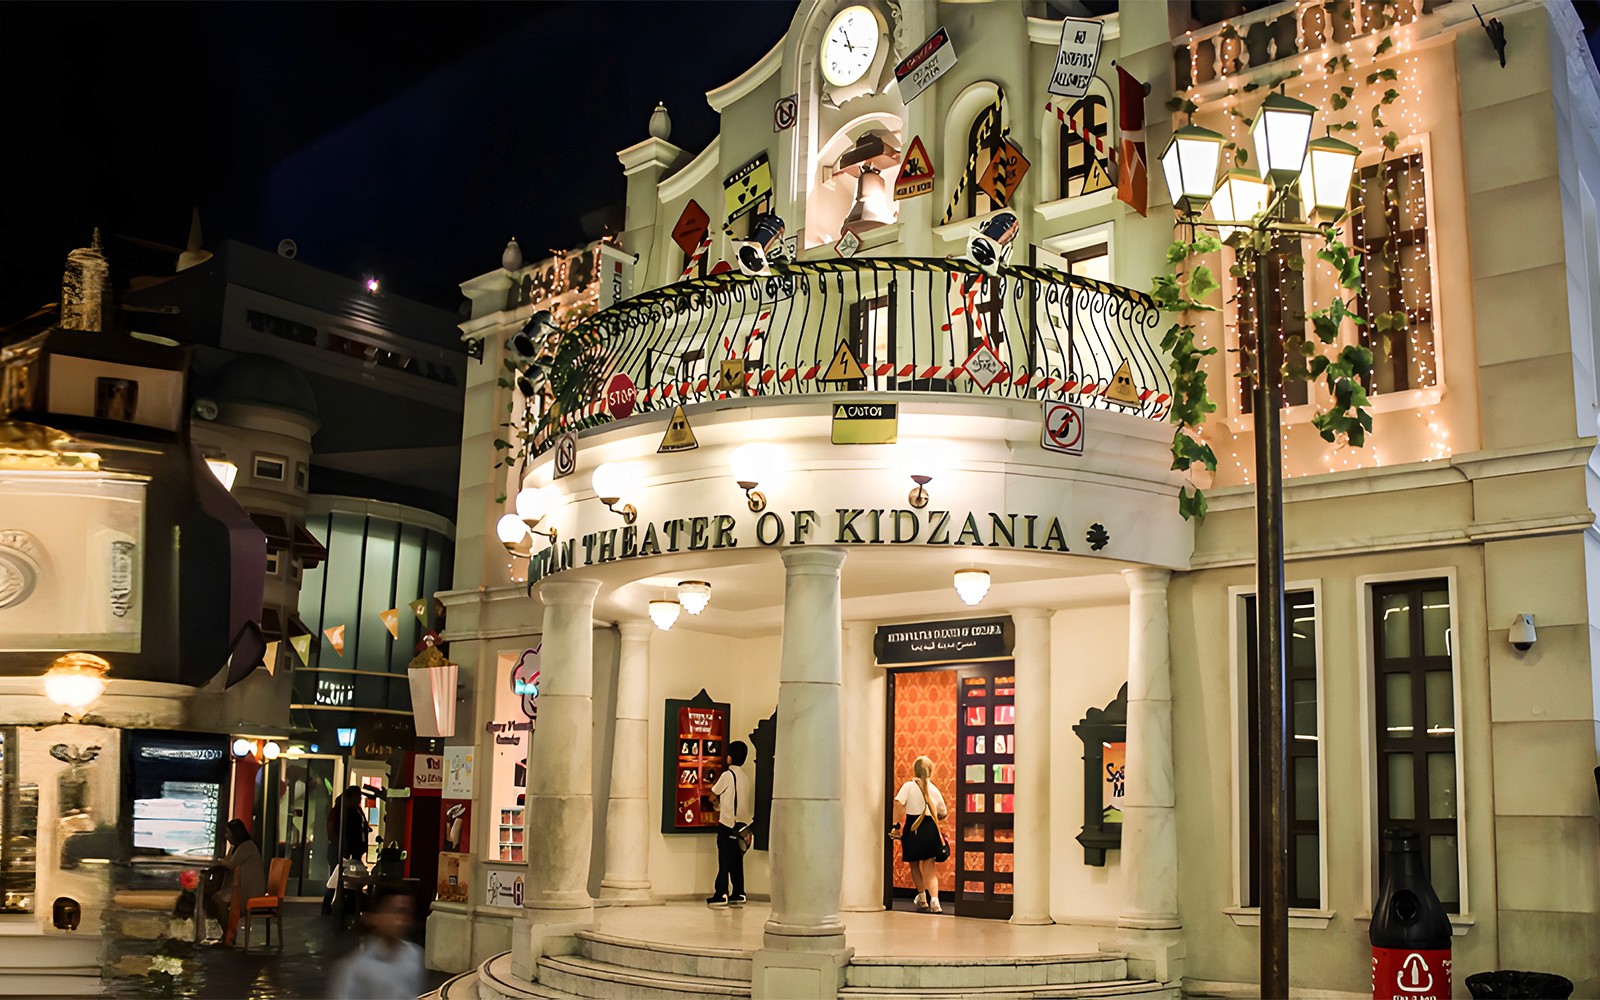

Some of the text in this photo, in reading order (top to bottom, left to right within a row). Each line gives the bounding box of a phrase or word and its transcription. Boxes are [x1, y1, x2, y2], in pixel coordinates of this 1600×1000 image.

[609, 387, 635, 406] STOP
[582, 515, 738, 565] THEATER
[756, 511, 815, 546] OF
[834, 508, 1071, 552] KIDZANIA
